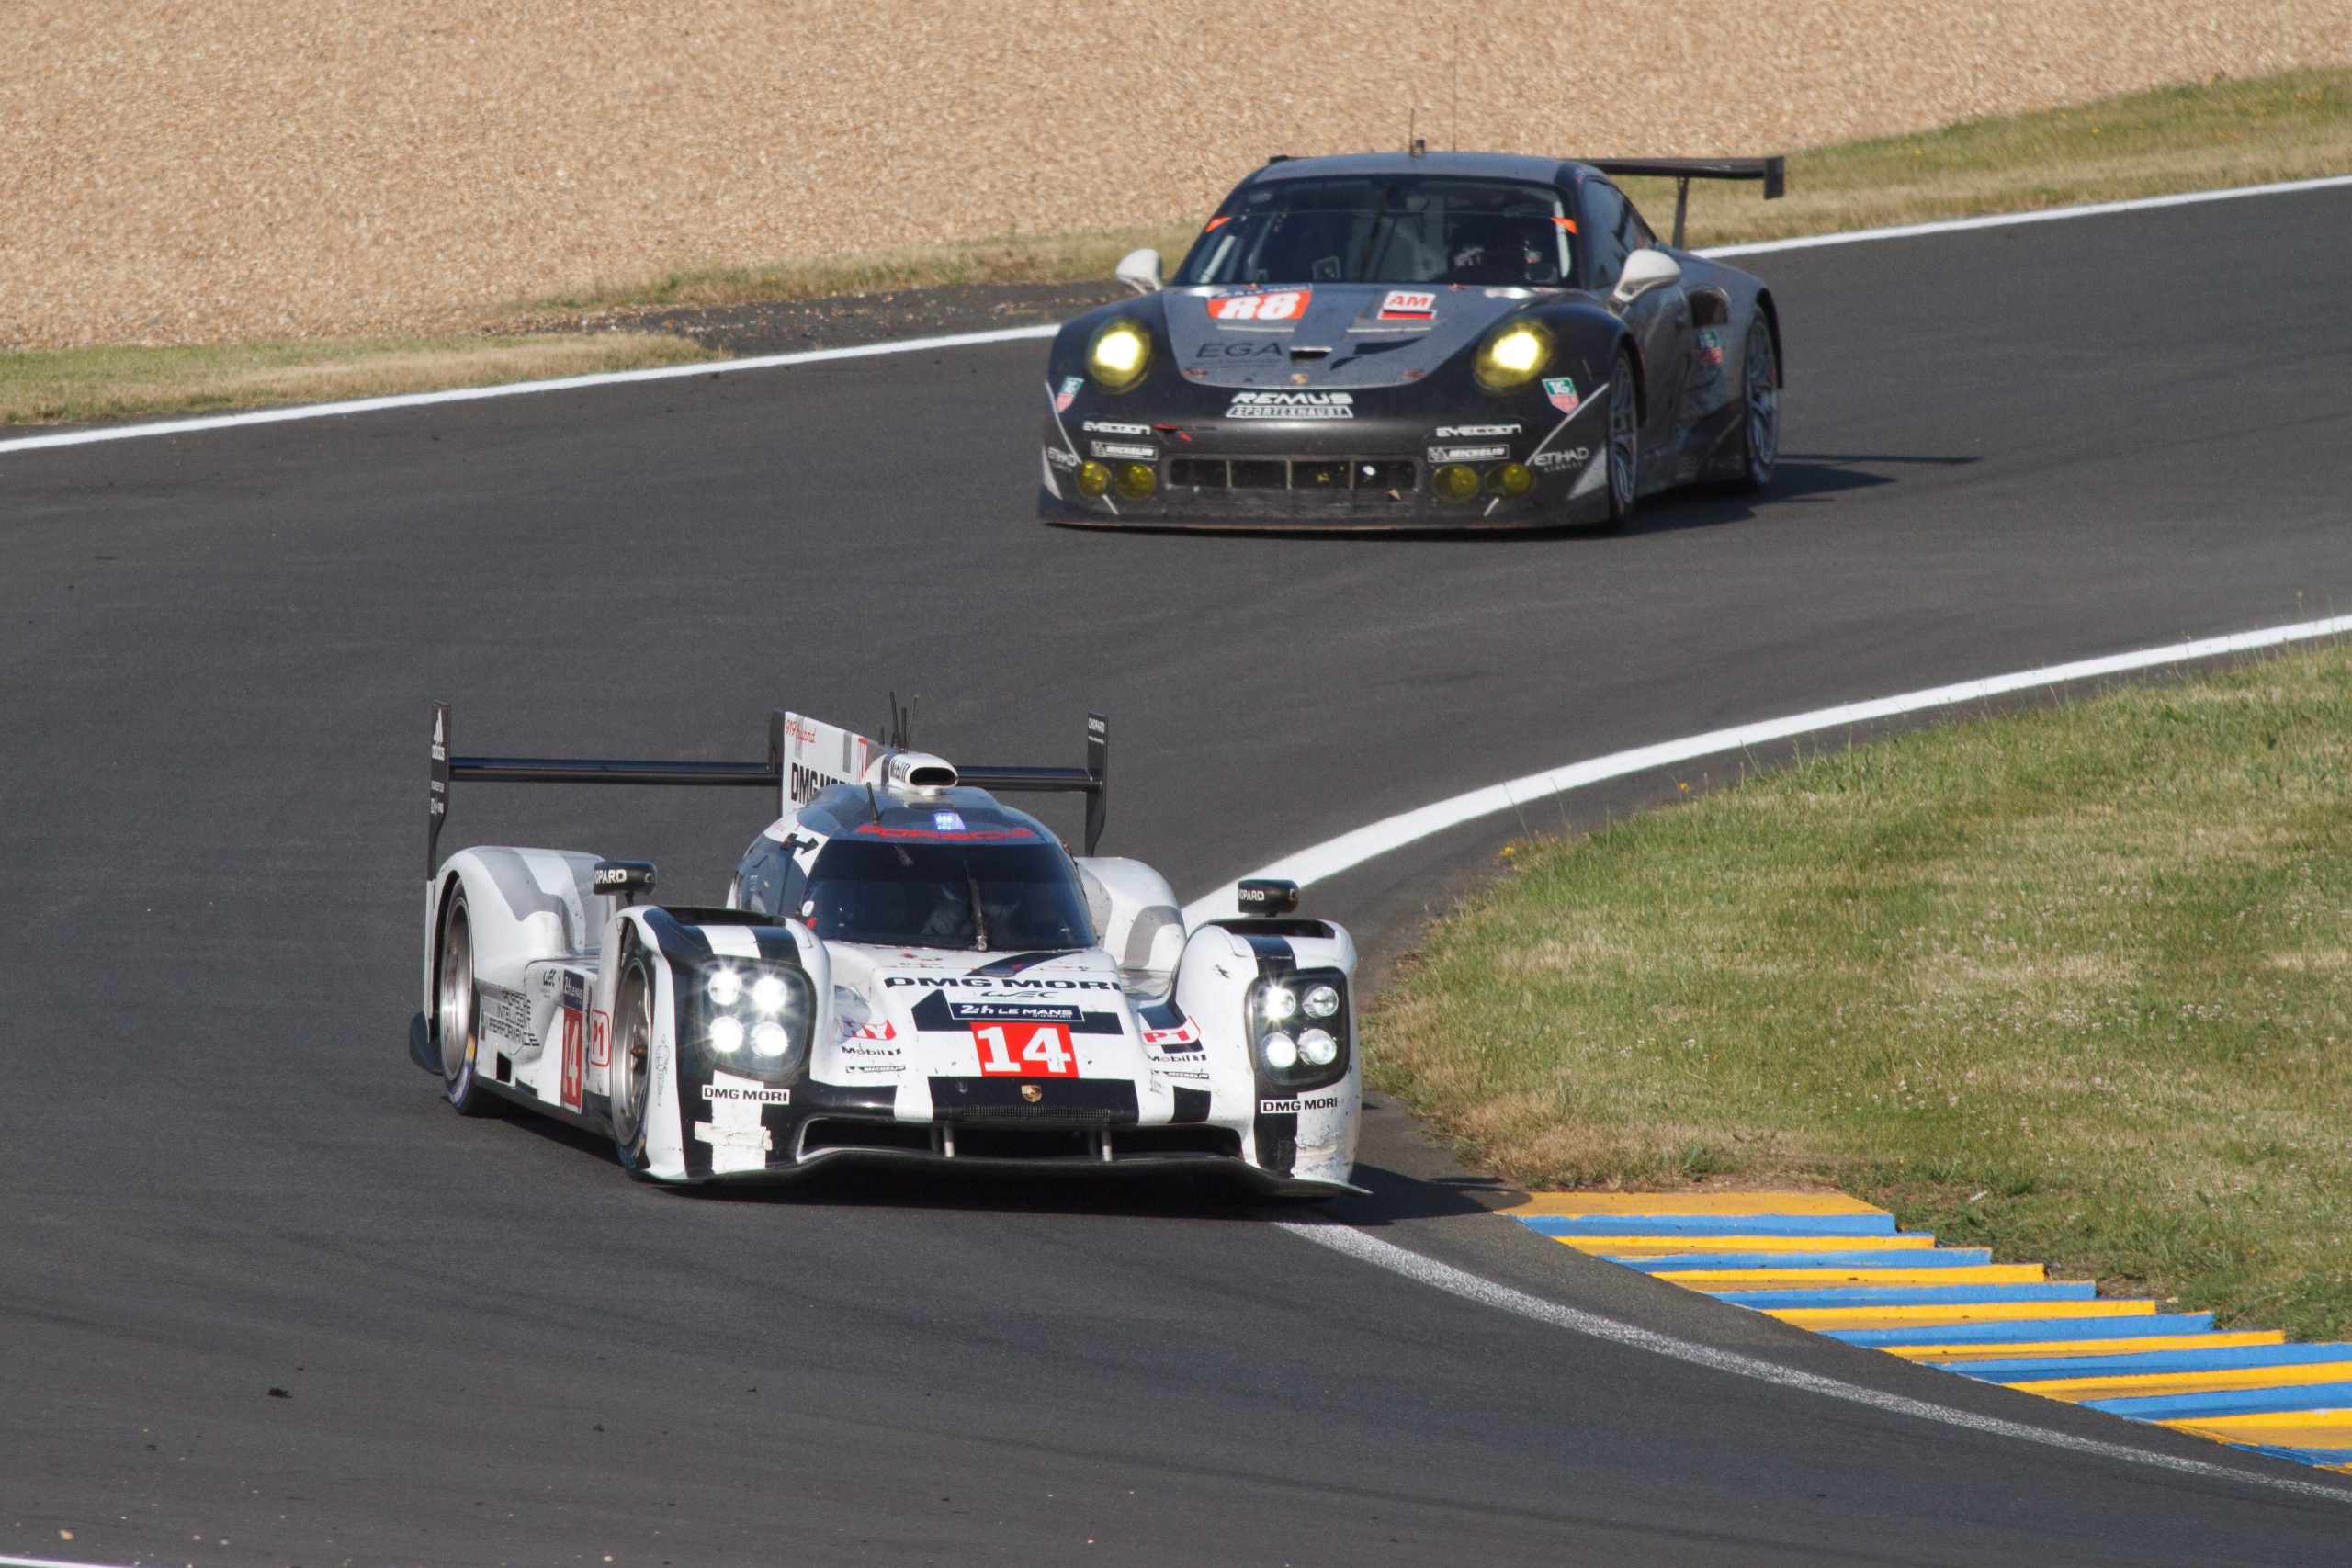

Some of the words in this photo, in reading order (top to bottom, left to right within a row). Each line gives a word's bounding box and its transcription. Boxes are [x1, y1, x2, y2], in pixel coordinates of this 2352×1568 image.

[1217, 292, 1301, 320] 88
[1387, 294, 1430, 306] AM
[1196, 343, 1283, 358] EGA
[1231, 392, 1353, 404] REMUS
[1235, 407, 1344, 417] SPORTEXHAUST
[1534, 447, 1589, 466] ETIHAD
[791, 762, 818, 807] DMG
[855, 825, 1037, 840] PORSCHE
[884, 976, 992, 989] DMG
[1001, 978, 1122, 990] MORI
[593, 1019, 604, 1056] P1
[1143, 1029, 1191, 1043] P1
[842, 1045, 886, 1056] Mobil
[978, 1026, 1072, 1073] 14
[563, 1018, 579, 1097] 14
[1168, 1071, 1209, 1079] MICHELIN
[704, 1088, 739, 1100] DMG
[742, 1089, 787, 1102] MORI
[1263, 1100, 1301, 1111] DMG
[1304, 1097, 1338, 1111] MORI
